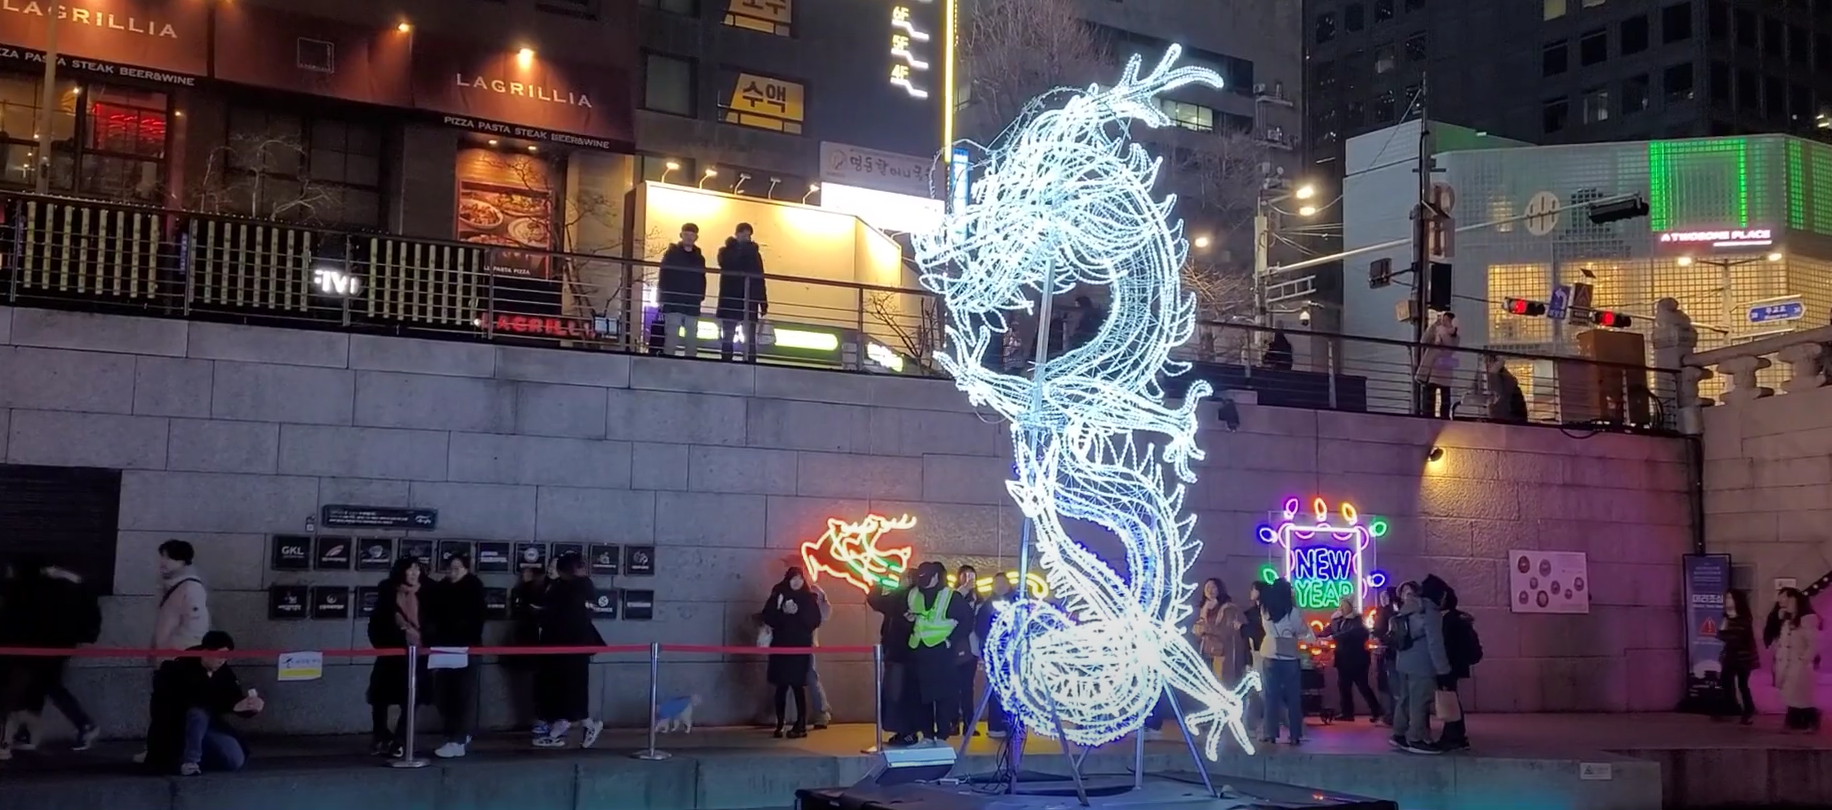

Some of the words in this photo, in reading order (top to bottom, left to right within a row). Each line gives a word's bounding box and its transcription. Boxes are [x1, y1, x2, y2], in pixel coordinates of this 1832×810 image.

[25, 52, 67, 67] PASA
[72, 60, 114, 74] STEAK
[120, 67, 196, 87] BEER&WINE
[456, 73, 593, 108] LAGRILLIA
[742, 80, 787, 113] 수액
[444, 116, 475, 128] PIZZA
[478, 121, 511, 134] PASTA
[514, 127, 548, 140] STEAK
[551, 133, 611, 149] BEER&WINE
[281, 546, 304, 555] GKL
[1295, 548, 1351, 581] NEW
